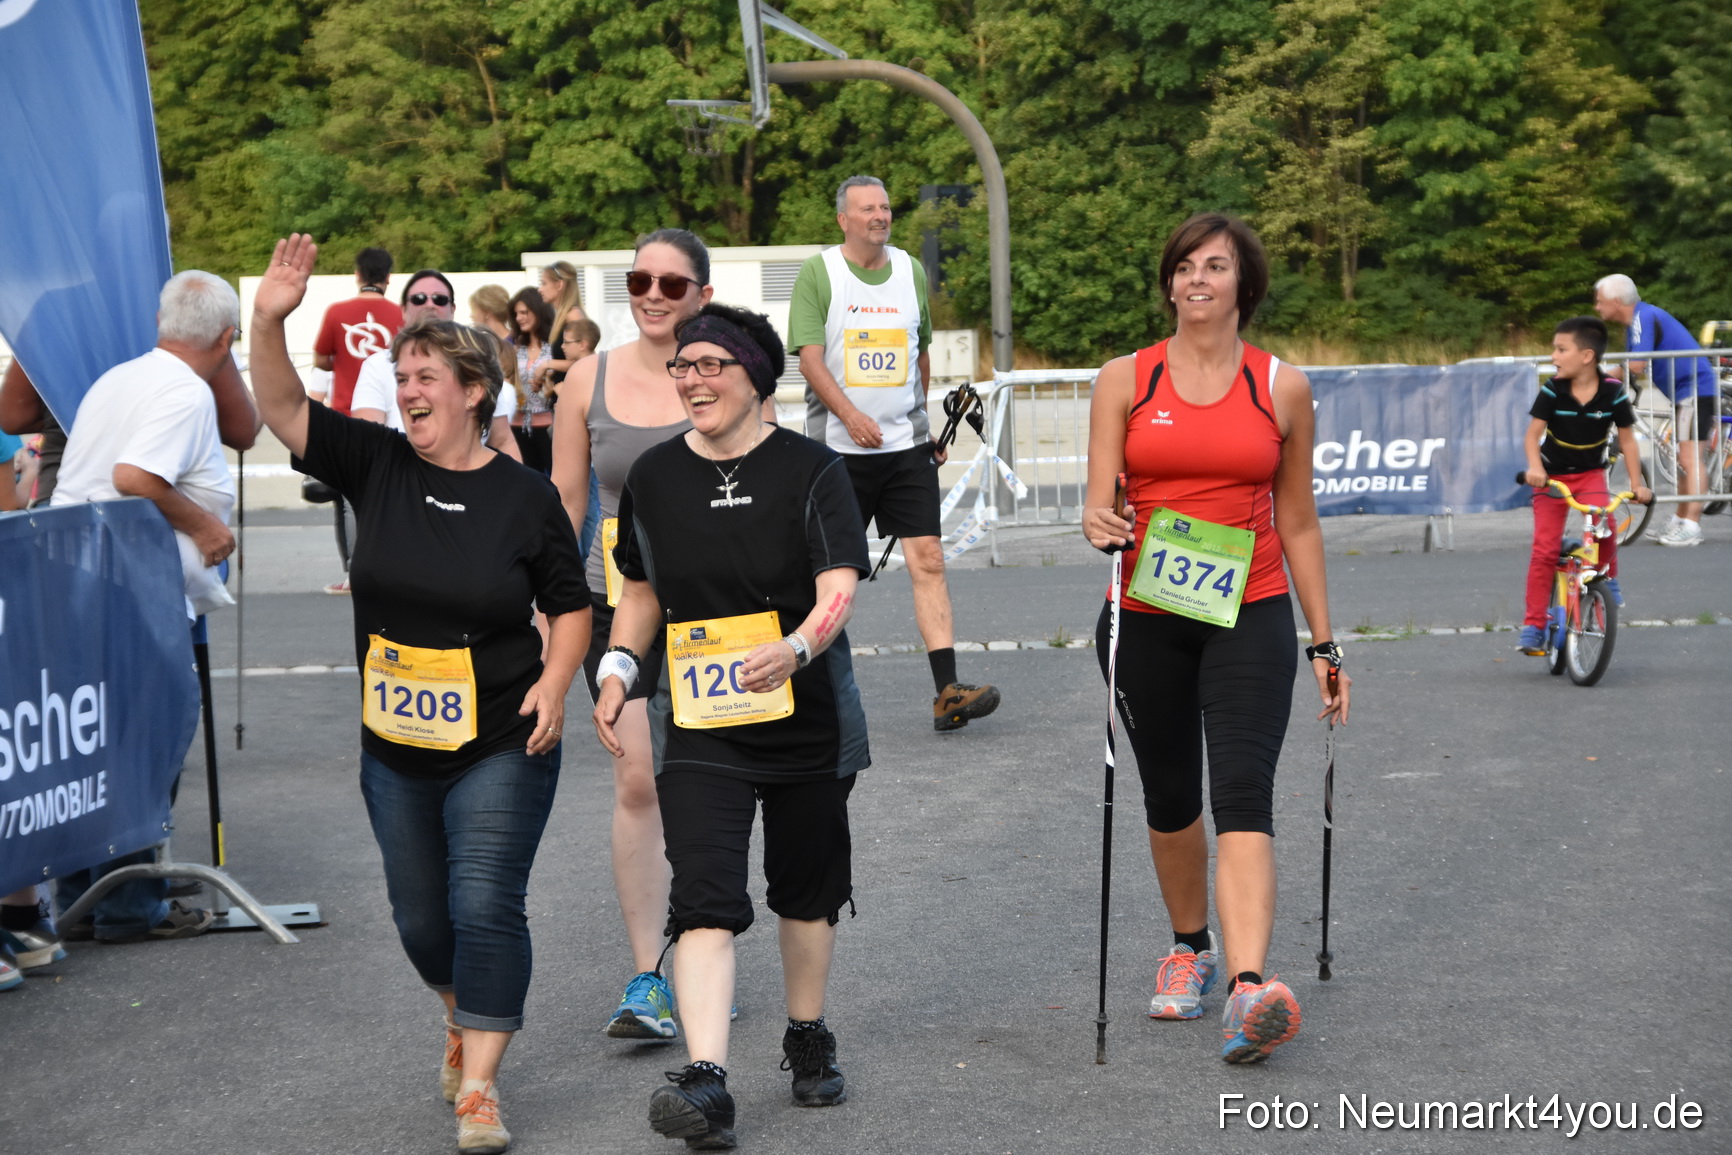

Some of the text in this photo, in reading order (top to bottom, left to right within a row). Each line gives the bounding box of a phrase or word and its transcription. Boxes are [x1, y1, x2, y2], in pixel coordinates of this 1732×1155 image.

[858, 352, 896, 371] 602
[1151, 549, 1236, 598] 1374
[1160, 588, 1185, 601] Daniela
[1185, 595, 1208, 607] Gruber
[683, 636, 722, 648] firmenlauf
[674, 651, 705, 661] walken
[374, 680, 463, 723] 1208
[712, 702, 751, 712] Sonja Seitz
[396, 723, 435, 735] Heidi Klose
[0, 770, 107, 839] TOMOBILE
